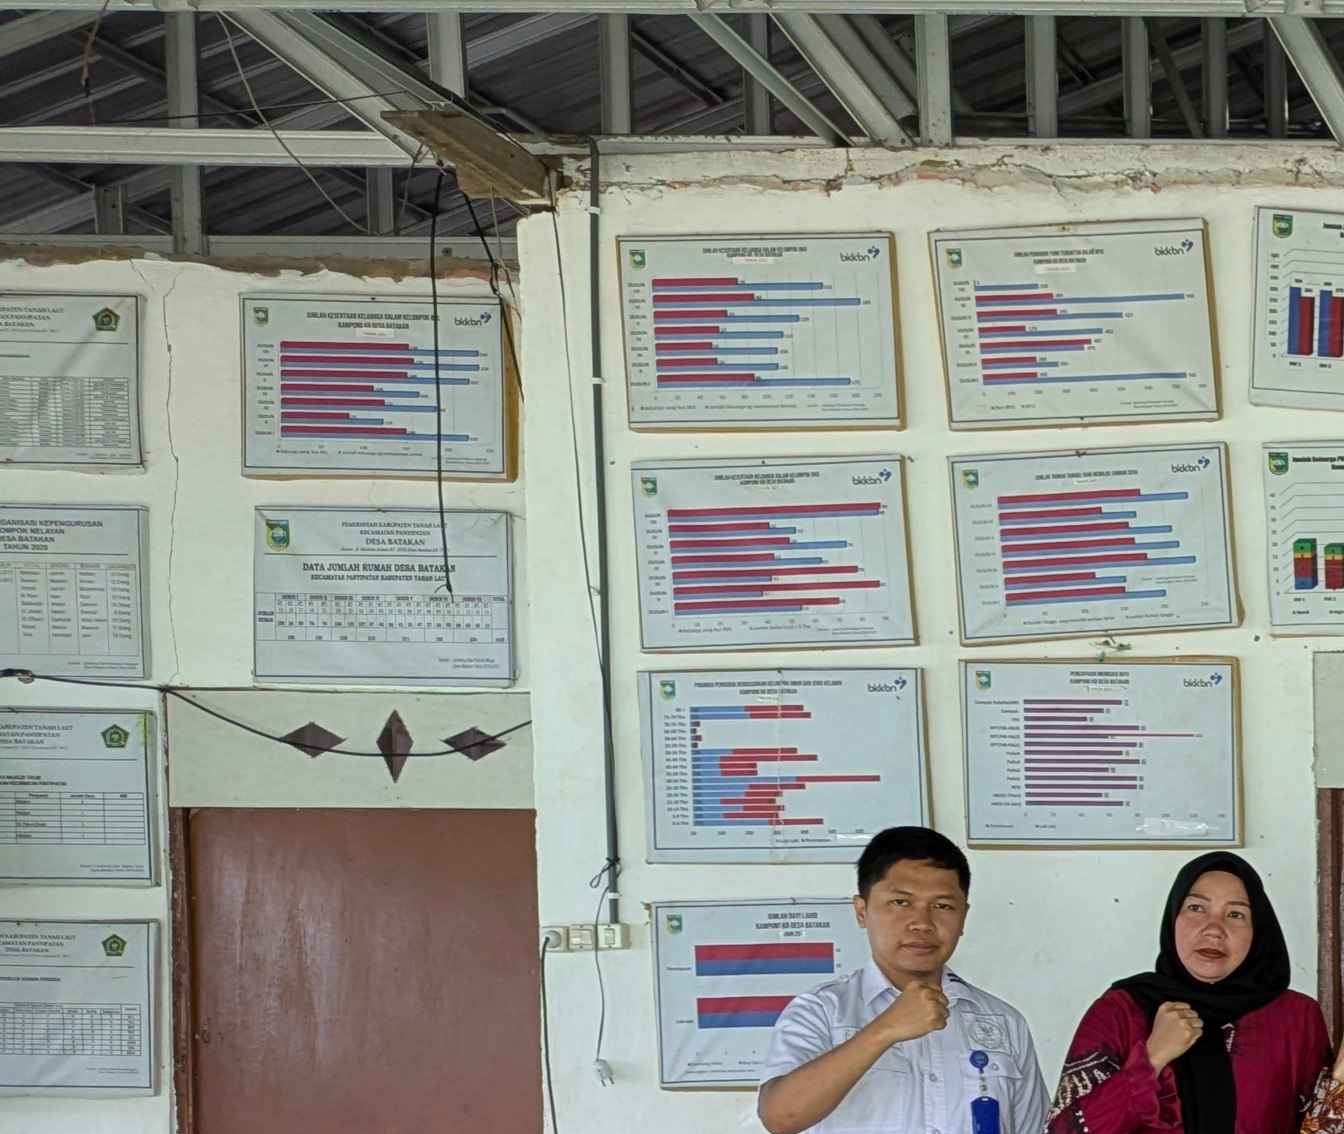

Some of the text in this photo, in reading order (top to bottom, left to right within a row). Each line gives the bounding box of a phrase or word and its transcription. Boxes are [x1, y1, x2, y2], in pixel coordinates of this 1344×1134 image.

[302, 563, 325, 572] DATA
[327, 563, 360, 572] JUMLAH
[362, 563, 392, 572] RUMAH
[394, 563, 416, 573] DESA
